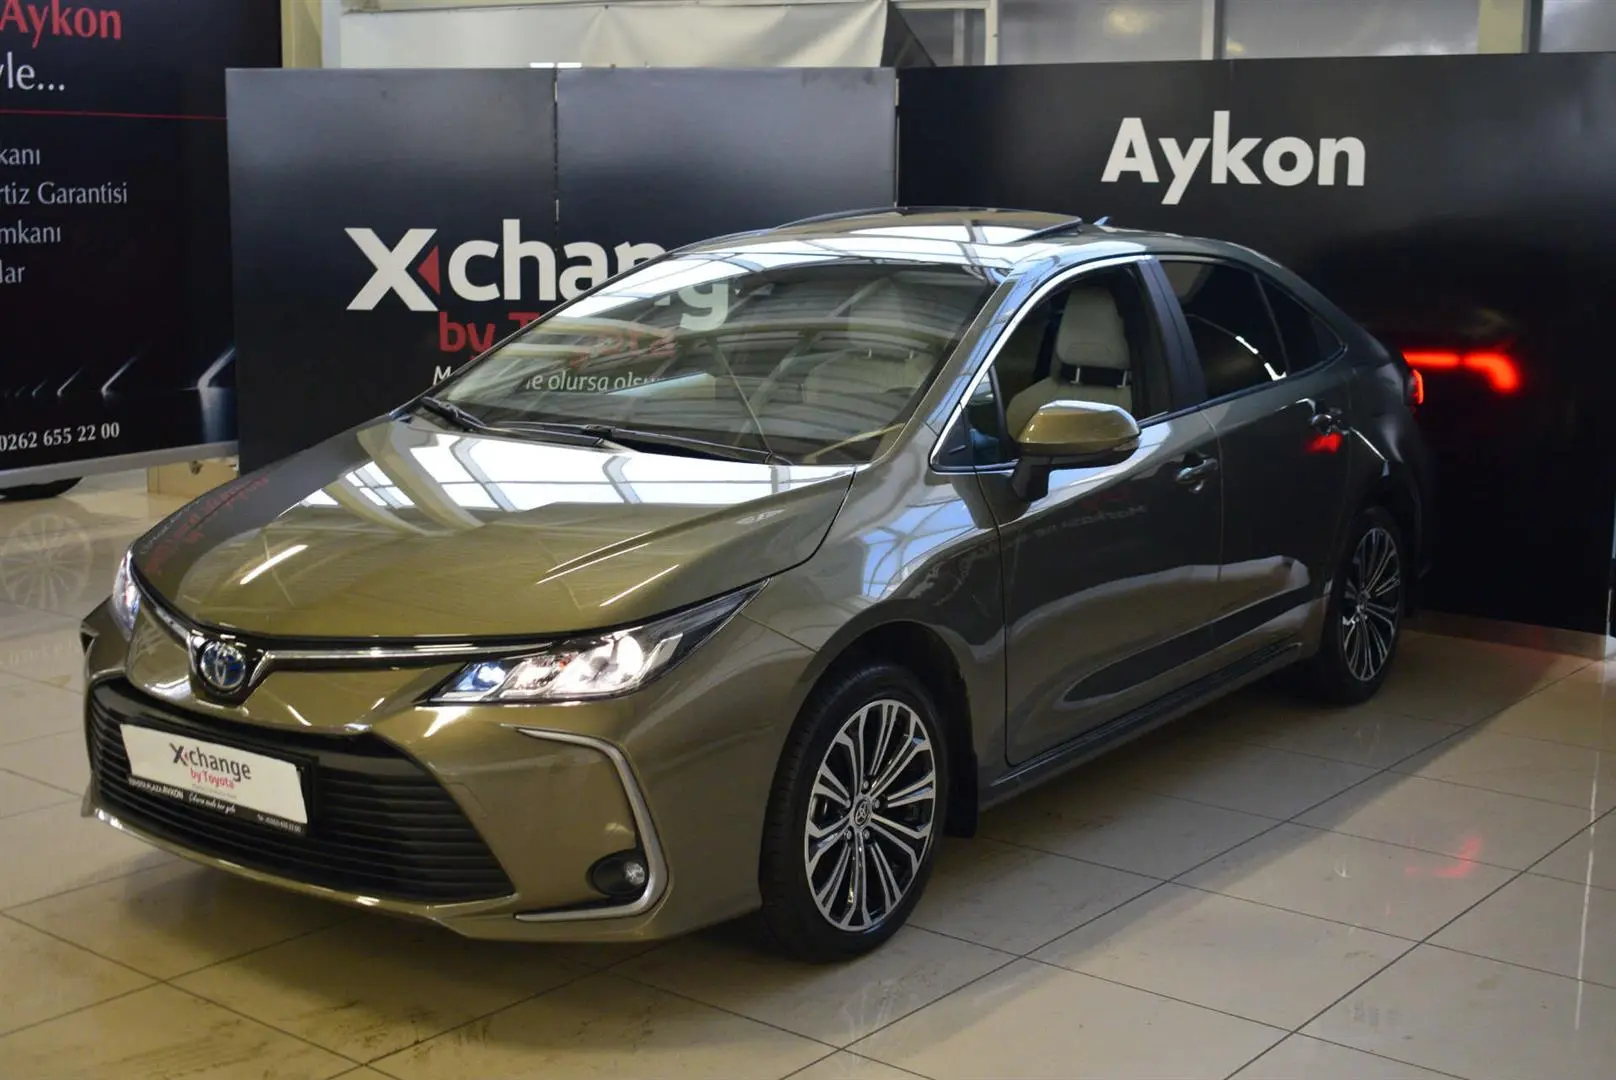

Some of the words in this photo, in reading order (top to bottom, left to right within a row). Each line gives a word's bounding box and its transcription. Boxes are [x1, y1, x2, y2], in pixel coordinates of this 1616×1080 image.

[0, 0, 122, 49] Aykon
[1100, 110, 1366, 205] Aykon
[37, 181, 128, 205] Garantisi
[438, 311, 496, 361] by
[547, 369, 609, 392] olursa
[0, 431, 38, 452] 0262
[43, 427, 73, 447] 655
[76, 424, 97, 443] 22
[100, 421, 120, 440] 00
[190, 767, 202, 784] by
[201, 769, 237, 790] Toyota
